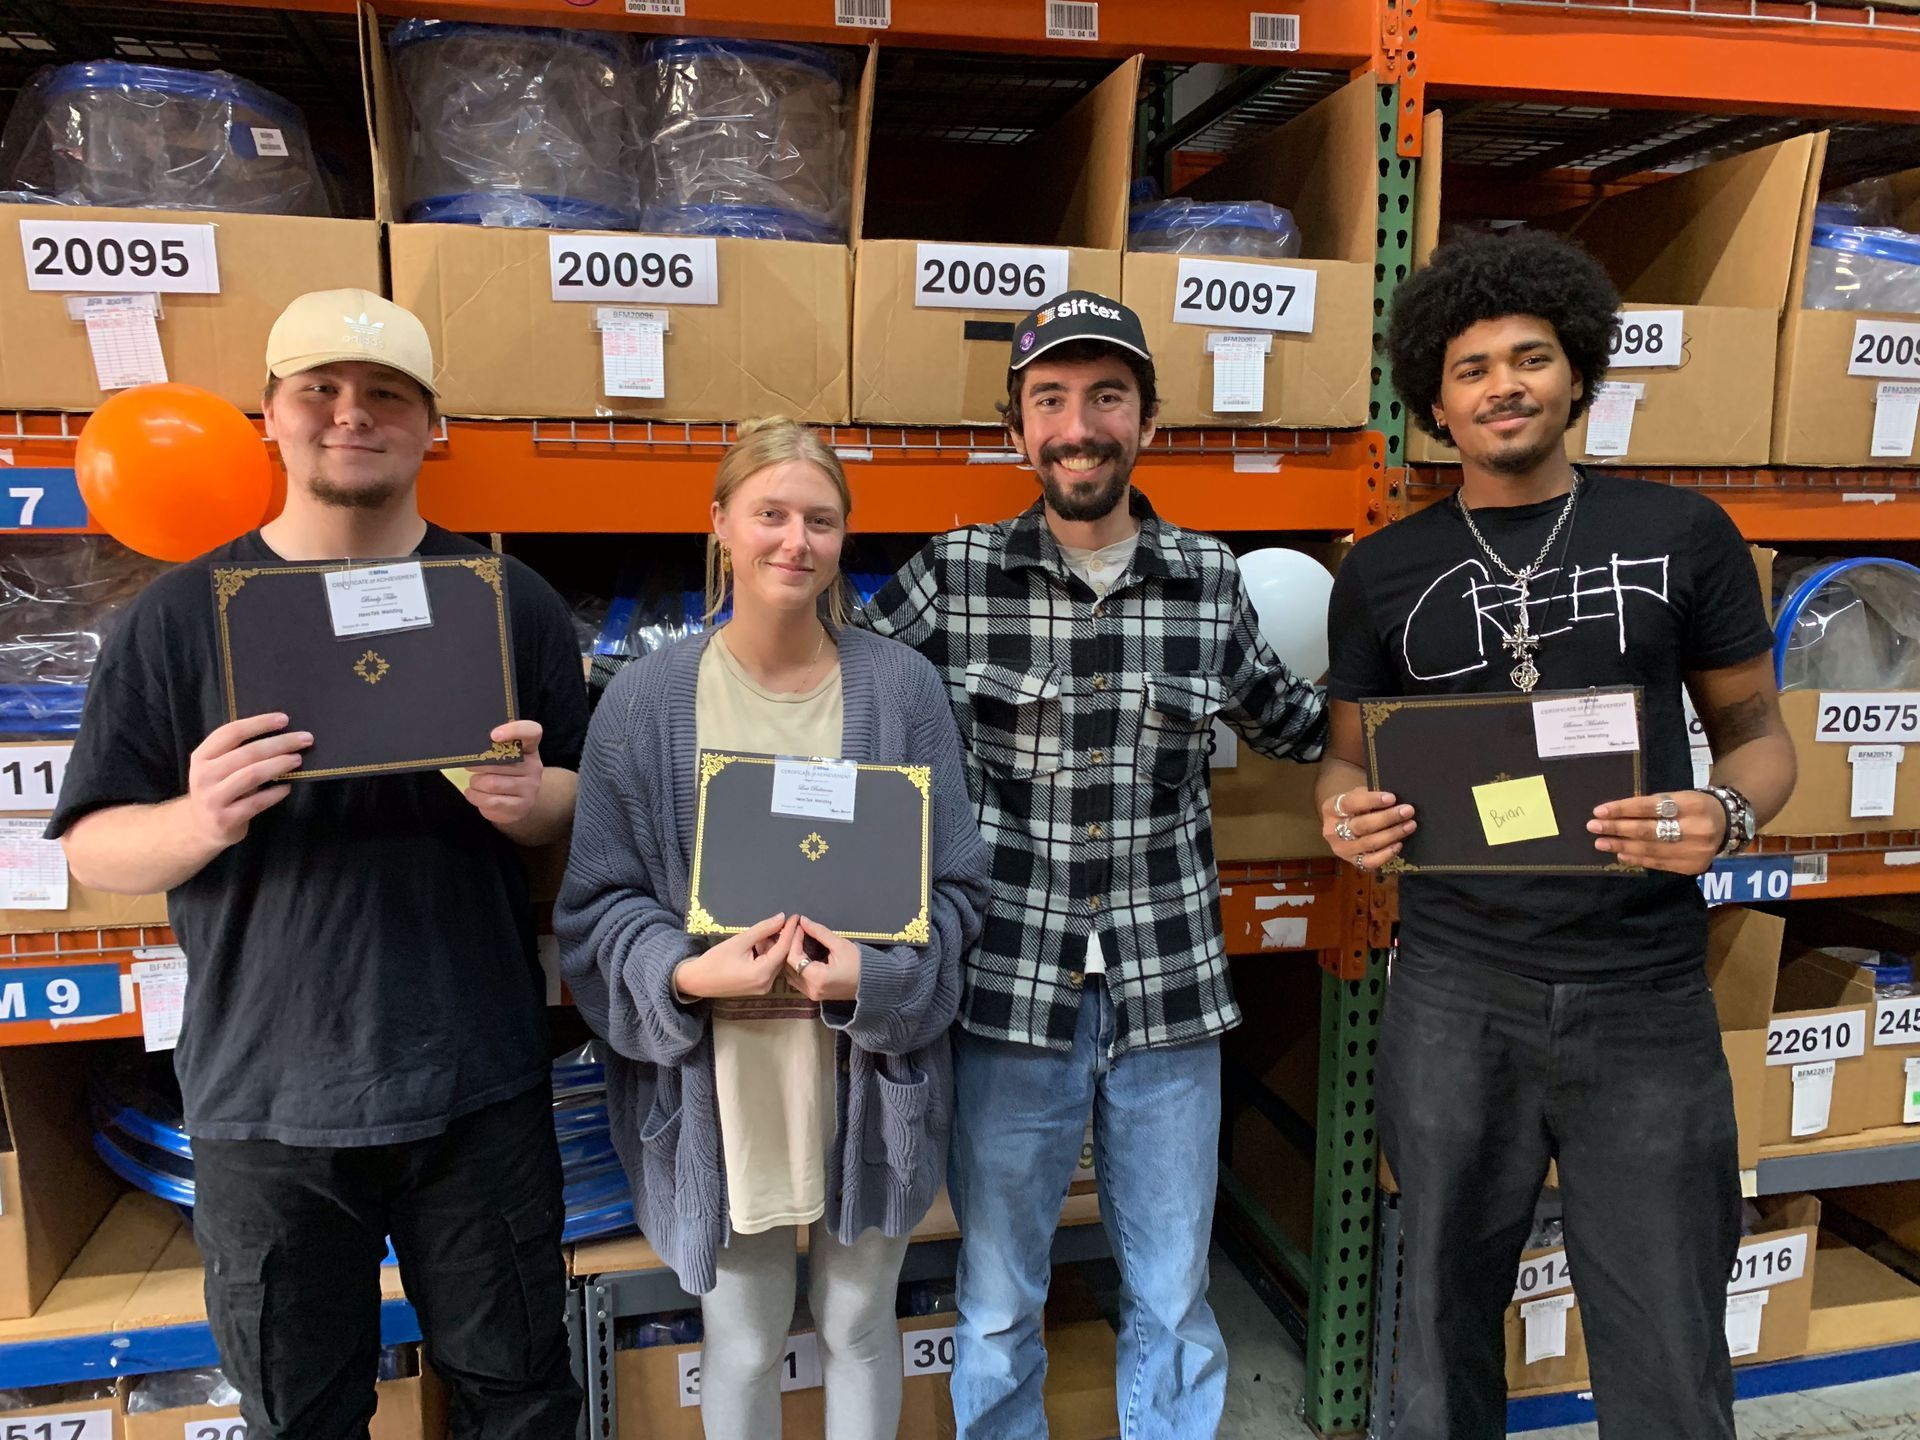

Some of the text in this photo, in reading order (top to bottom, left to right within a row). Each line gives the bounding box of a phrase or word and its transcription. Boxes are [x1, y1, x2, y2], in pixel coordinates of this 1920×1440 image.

[31, 237, 190, 278] 20095
[557, 251, 694, 288] 20096
[921, 259, 1047, 298] 20096
[1057, 298, 1122, 321] Siftex
[1179, 276, 1297, 317] 20097
[612, 310, 655, 320] BFM20096
[8, 487, 45, 526] 7
[1821, 704, 1919, 733] 20575
[1858, 751, 1894, 759] BFM20575
[1488, 805, 1526, 829] Brian
[1746, 869, 1789, 899] 10
[45, 978, 81, 1015] 9
[1766, 1022, 1851, 1056] 22610
[1797, 1066, 1834, 1078] BFM22610
